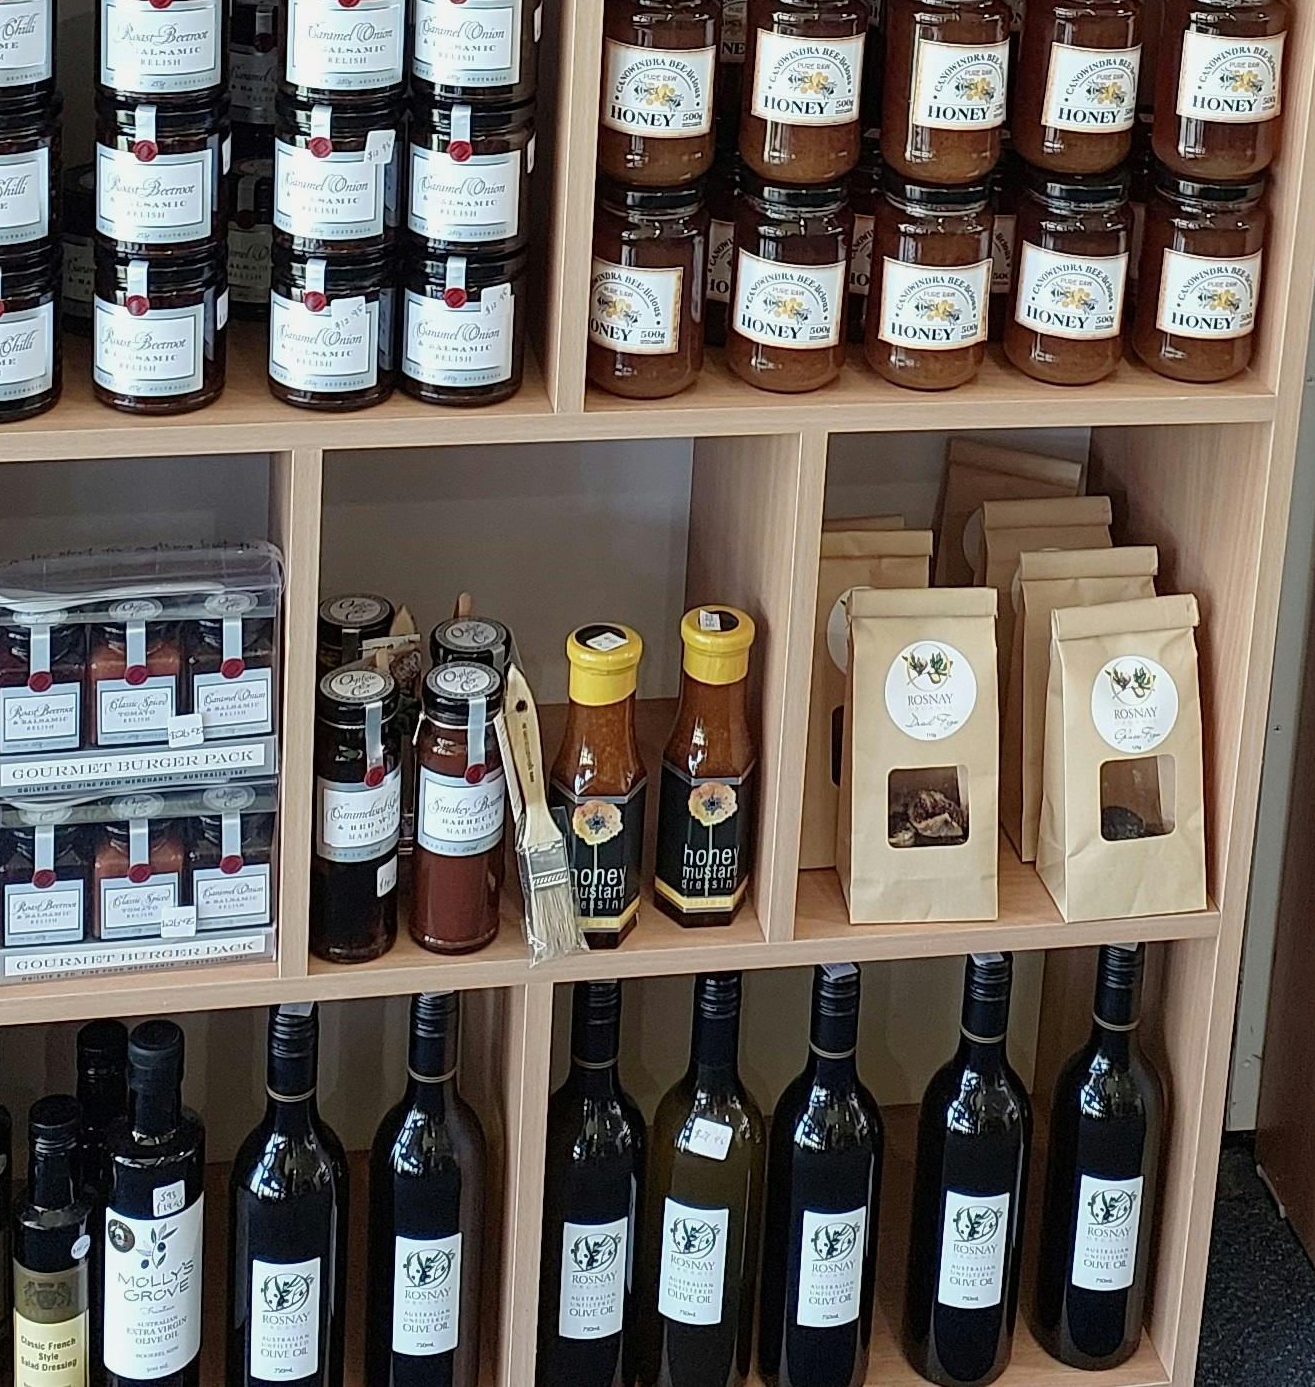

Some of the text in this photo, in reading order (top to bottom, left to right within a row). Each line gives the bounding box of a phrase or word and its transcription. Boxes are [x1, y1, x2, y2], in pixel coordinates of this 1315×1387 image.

[464, 21, 505, 41] Onion
[610, 105, 706, 128] HONEY 500g
[739, 313, 804, 341] HONEY
[890, 321, 954, 341] HONEY
[907, 693, 953, 706] ROSNAY
[1114, 706, 1157, 719] ROSNAY
[11, 749, 254, 781] GOURMET BURGER PACK
[684, 844, 739, 868] honey
[952, 1243, 997, 1255] ROSNAY
[670, 1254, 716, 1272] ROSNAY
[571, 1272, 618, 1285] ROSNAY
[123, 1280, 190, 1301] GROVE
[405, 1287, 451, 1301] ROSNAY
[126, 1317, 187, 1337] EXTRA VIRGIN
[403, 1322, 449, 1333] OLIVE OIL
[21, 1335, 76, 1351] Classic French
[135, 1330, 179, 1344] OLIVE OIL
[21, 1357, 77, 1372] Salad Dressing
[38, 1351, 59, 1363] Style
